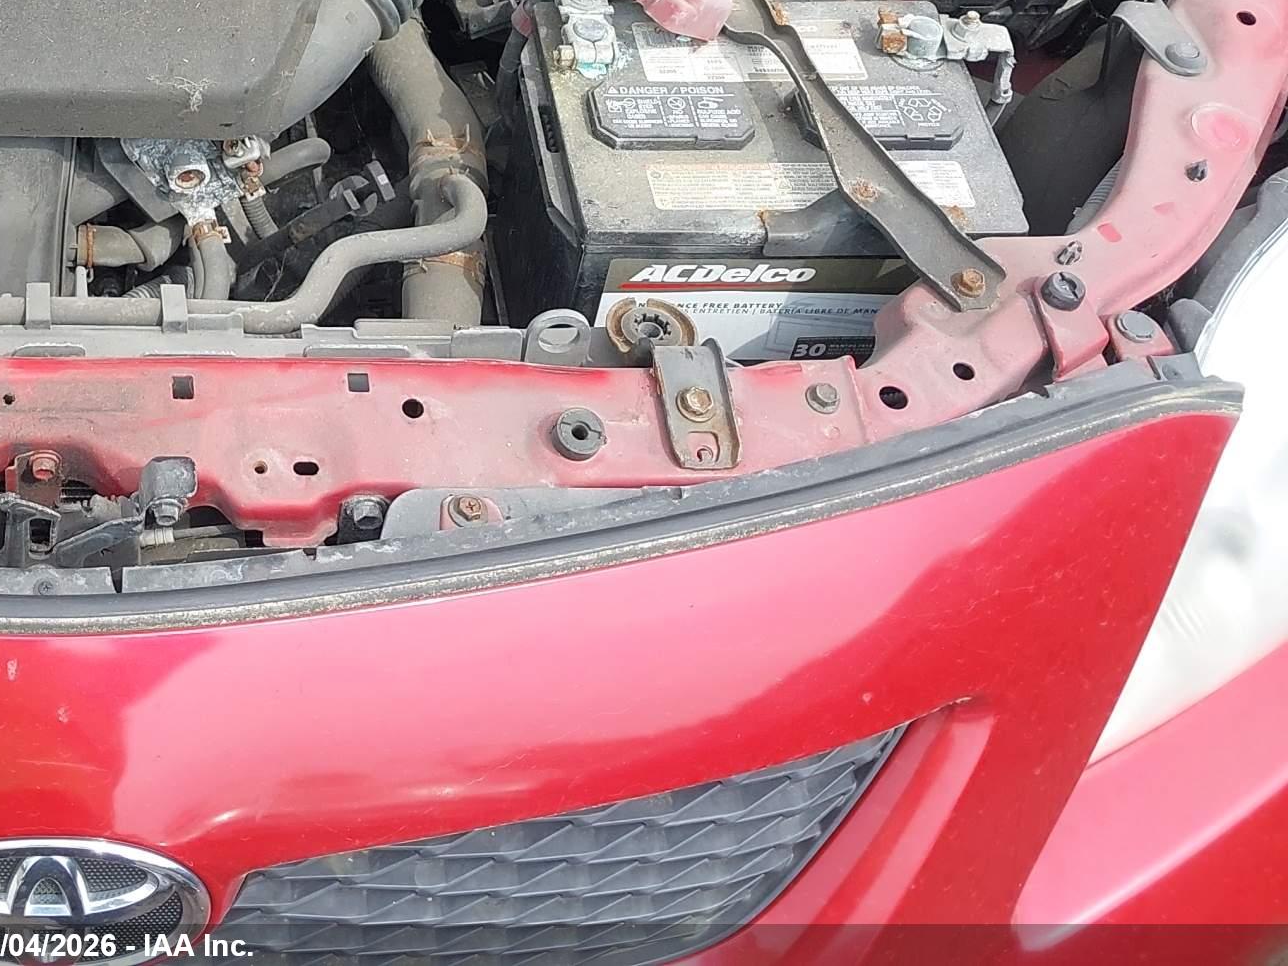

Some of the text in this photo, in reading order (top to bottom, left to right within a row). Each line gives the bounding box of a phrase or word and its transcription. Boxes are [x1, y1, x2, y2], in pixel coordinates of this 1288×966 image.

[619, 86, 668, 94] DANGER
[679, 86, 724, 94] POISON
[629, 264, 817, 283] ACDelco
[793, 343, 827, 358] 30
